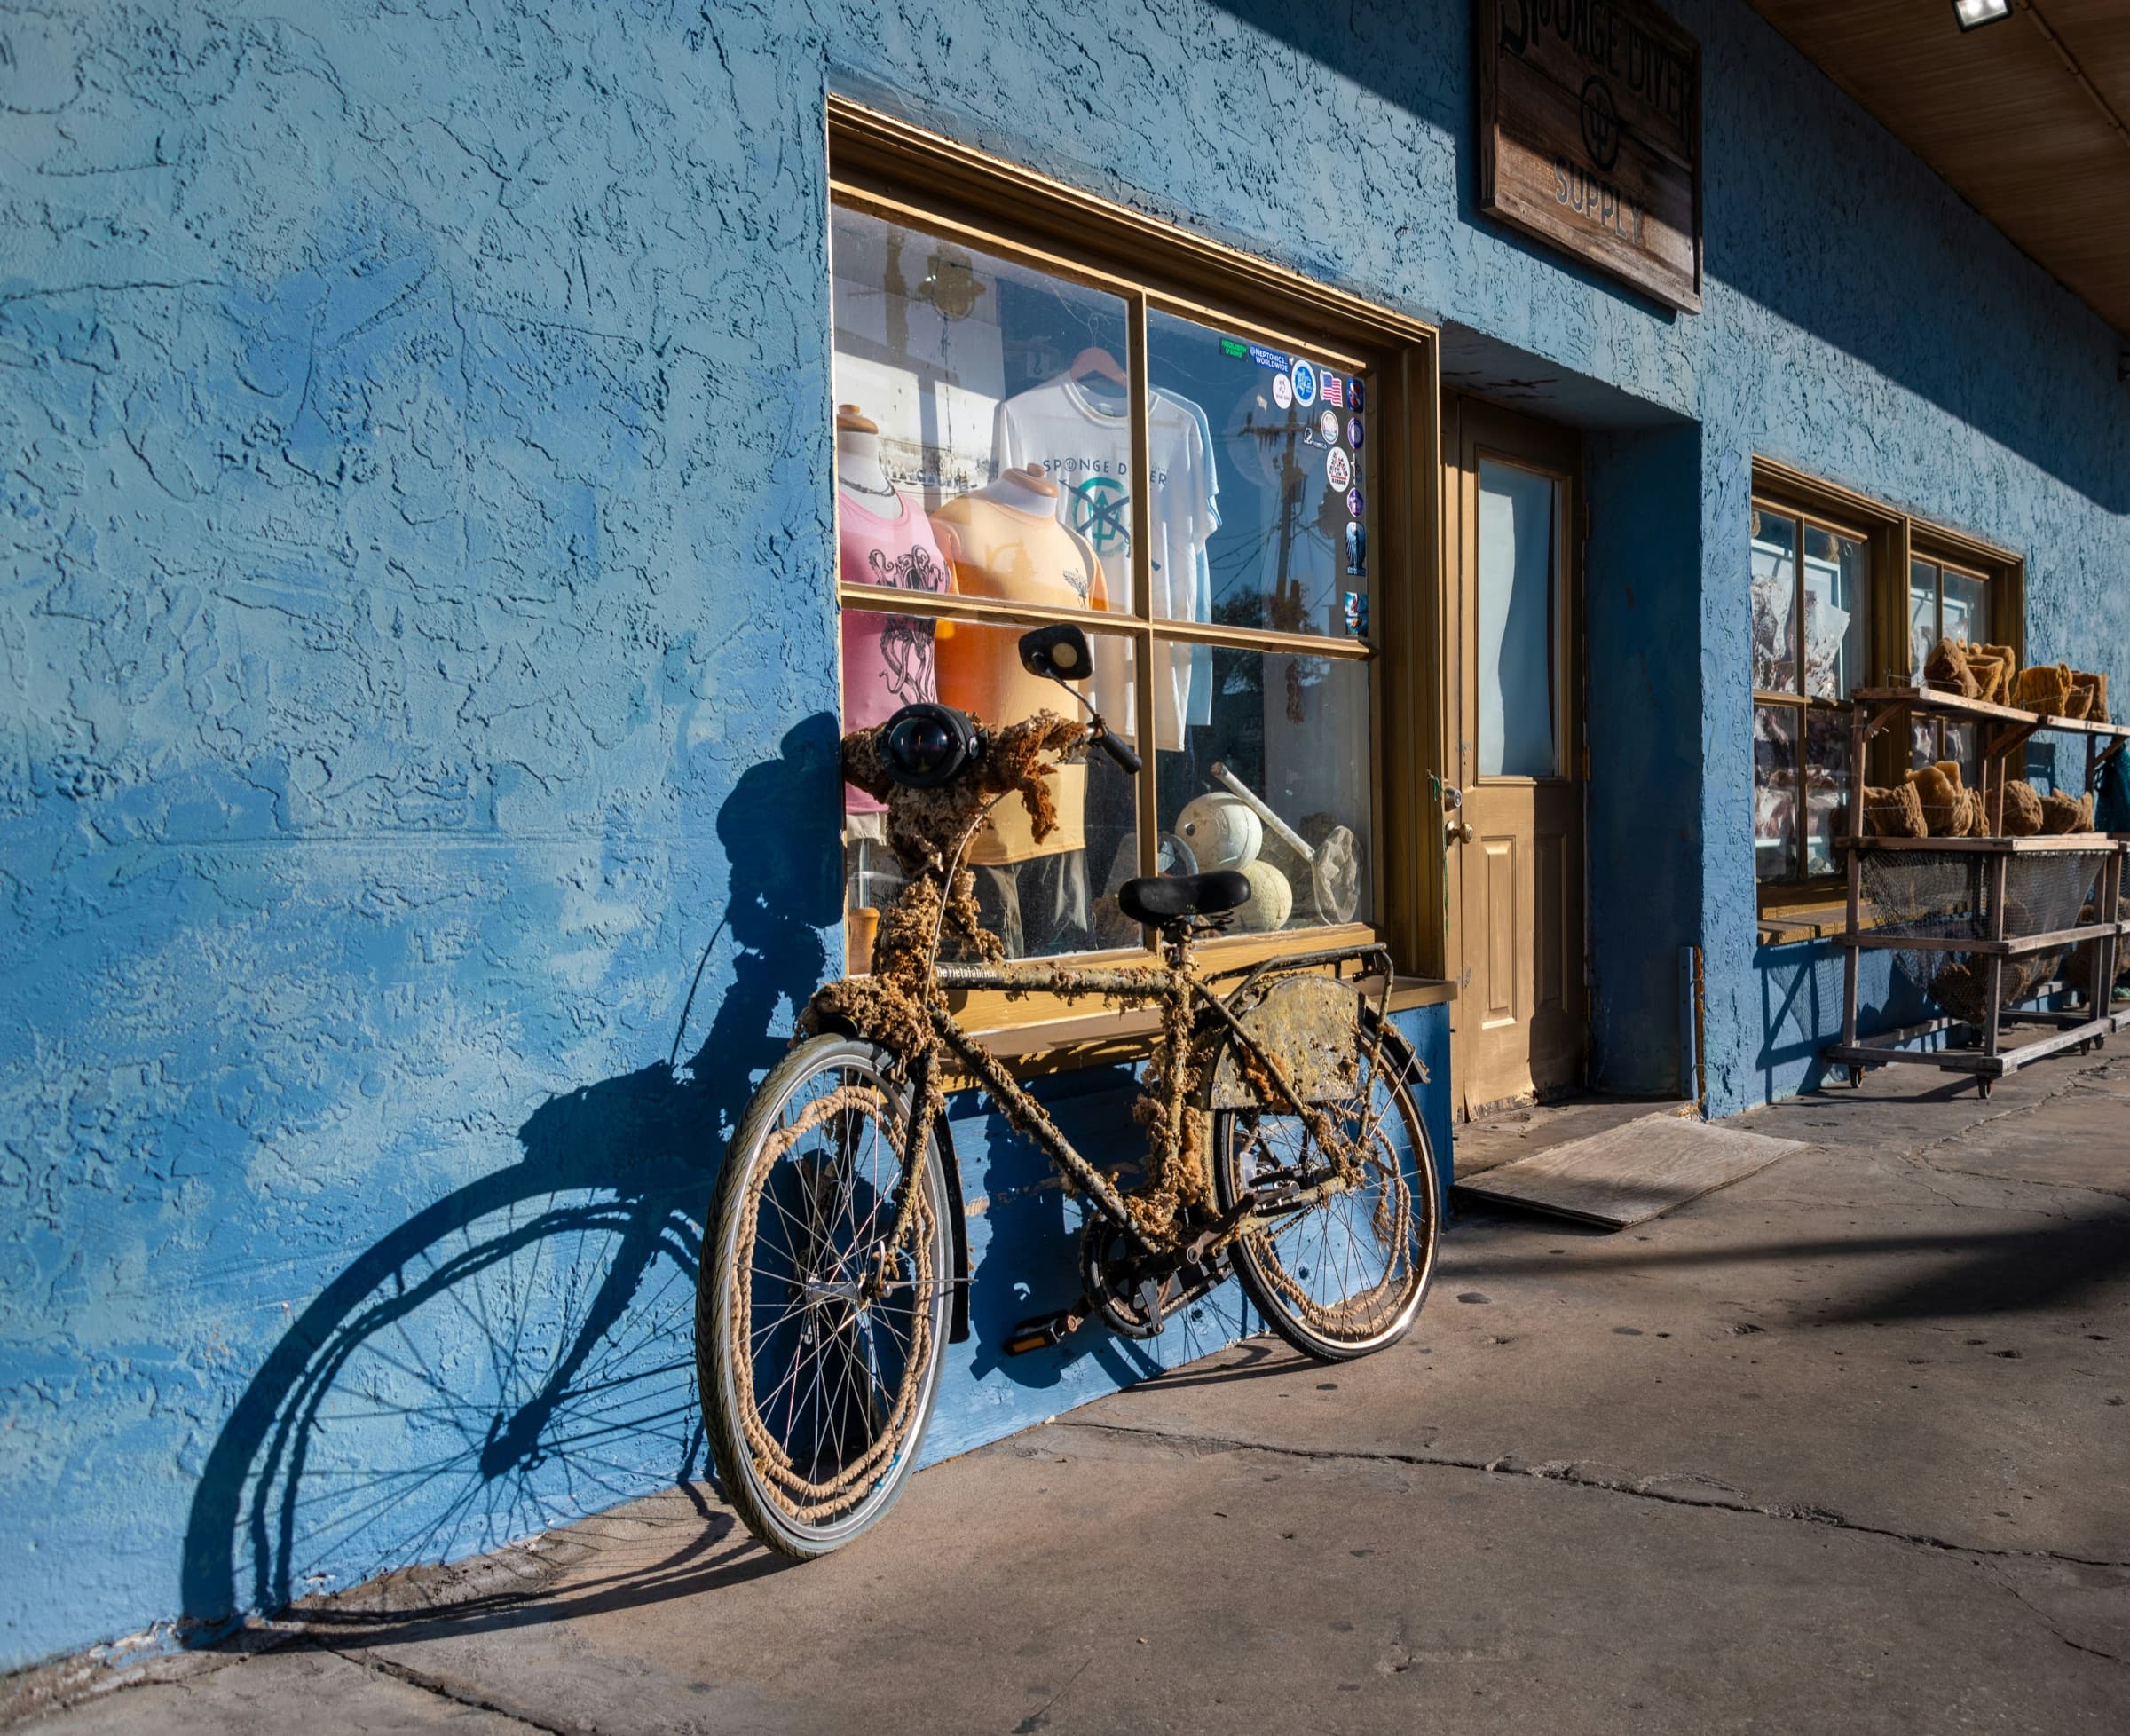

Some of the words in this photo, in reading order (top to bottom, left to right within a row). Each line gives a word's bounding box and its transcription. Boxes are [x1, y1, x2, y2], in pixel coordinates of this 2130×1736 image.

[1555, 156, 1643, 244] SUPPLY
[1256, 357, 1288, 372] WORLDWIDE
[1043, 457, 1108, 473] SPONGE
[1118, 462, 1167, 486] DER
